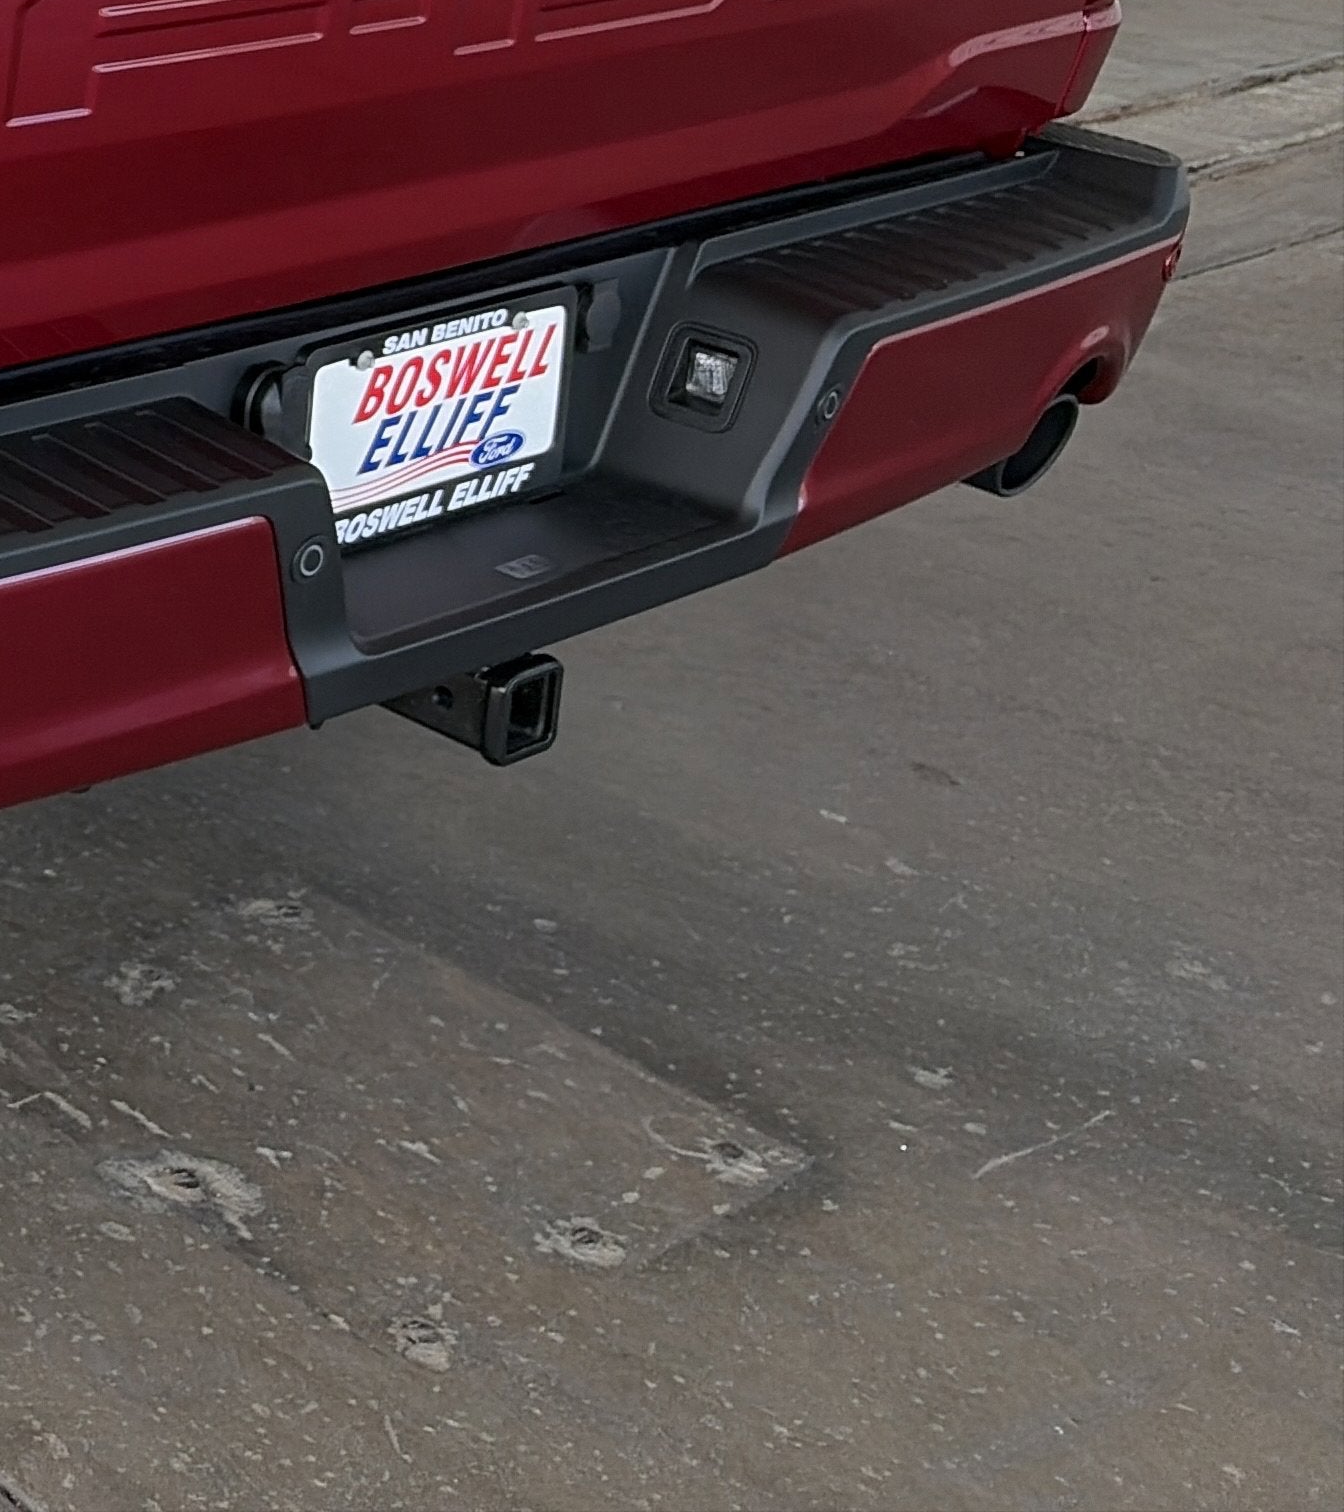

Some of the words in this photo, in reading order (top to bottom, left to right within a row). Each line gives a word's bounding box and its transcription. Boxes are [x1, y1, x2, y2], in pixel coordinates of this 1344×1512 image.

[382, 335, 426, 355] SAN
[431, 308, 509, 342] BENITO
[352, 324, 557, 425] BOSWELL
[356, 383, 521, 476] ELLIFF
[478, 435, 516, 462] Ford
[334, 489, 445, 544] BOSWELL
[447, 462, 536, 512] ELLIFF
